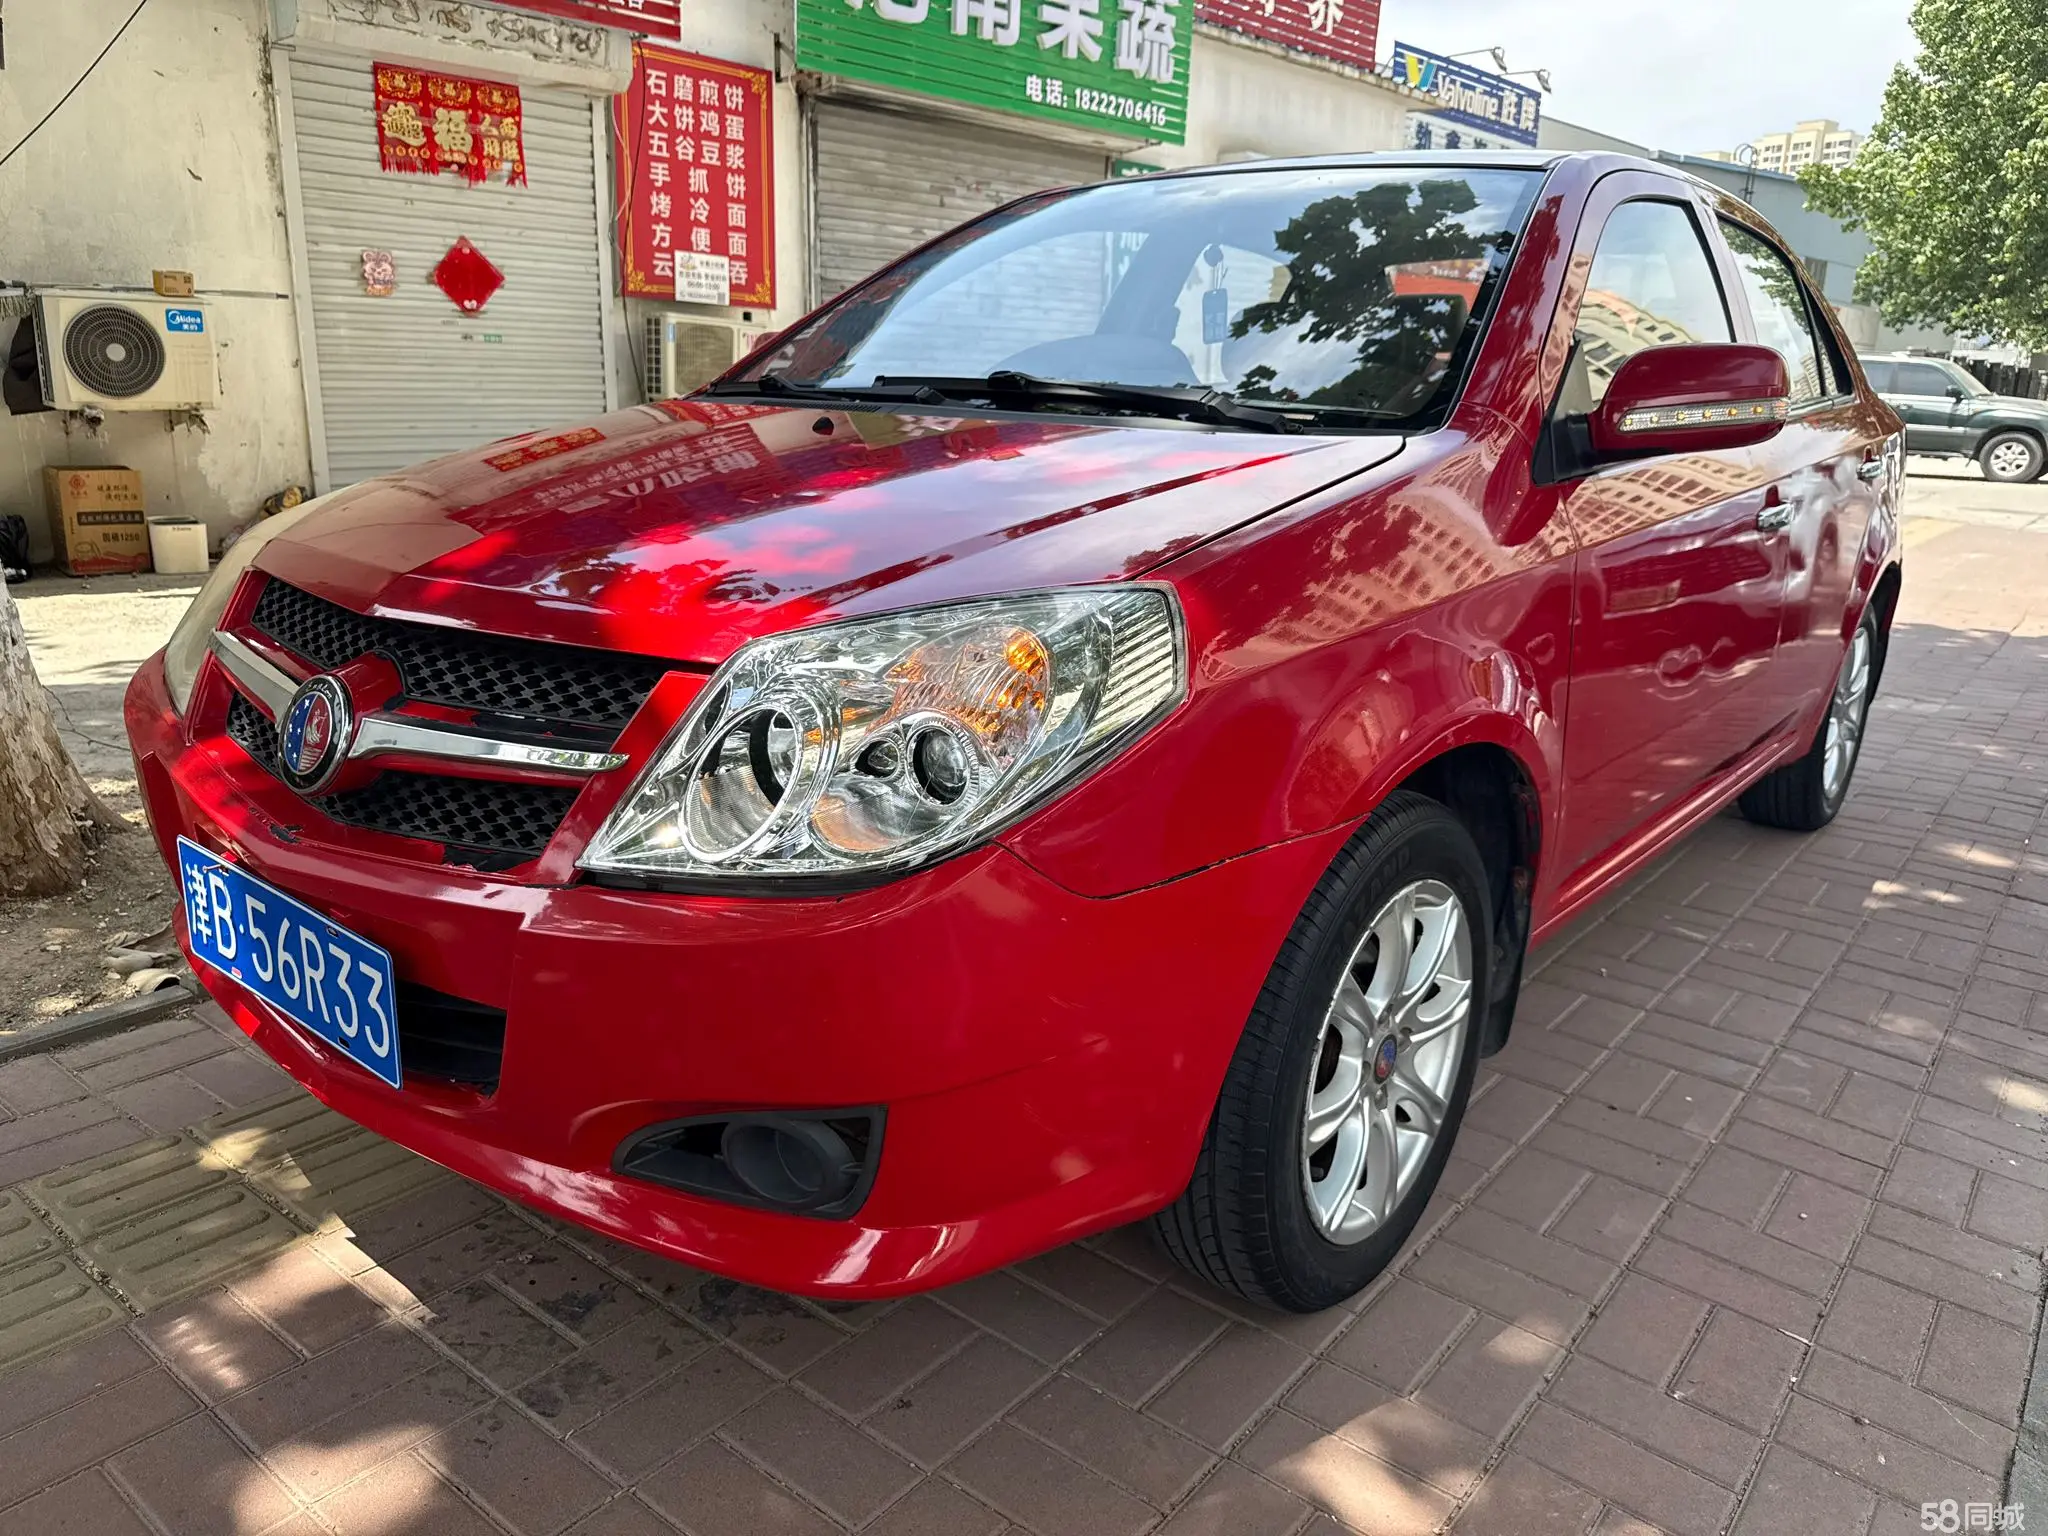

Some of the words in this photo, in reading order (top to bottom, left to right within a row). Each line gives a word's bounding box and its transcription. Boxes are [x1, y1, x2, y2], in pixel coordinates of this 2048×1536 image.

[645, 69, 745, 112] 石磨煎饼
[1074, 87, 1167, 127] 18222706416
[1437, 72, 1499, 121] Valvoline
[432, 107, 473, 154] 福
[646, 100, 745, 142] 大饼鸡蛋
[648, 130, 746, 170] 五谷豆浆
[649, 161, 747, 200] 手抓饼
[650, 190, 747, 229] 烤冷面
[651, 222, 748, 258] 方便面
[185, 862, 391, 1058] 津B·56R33
